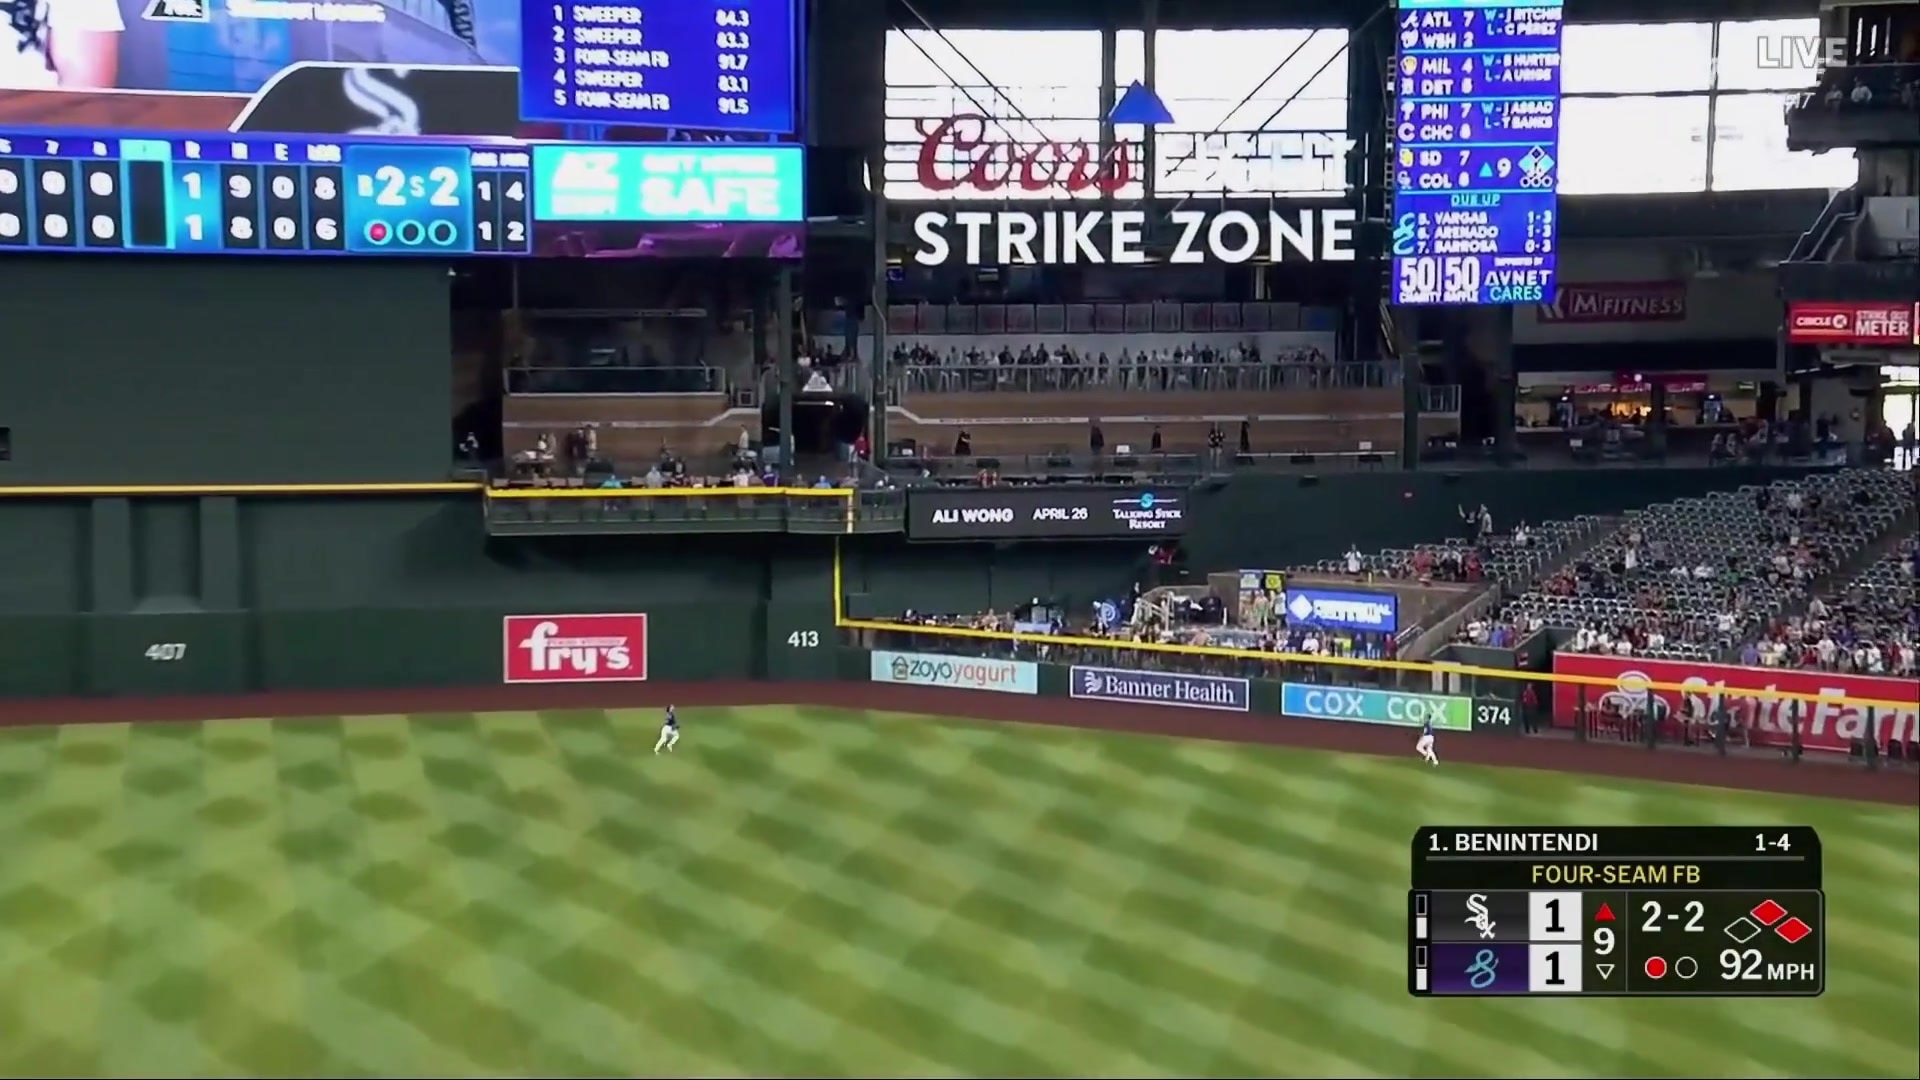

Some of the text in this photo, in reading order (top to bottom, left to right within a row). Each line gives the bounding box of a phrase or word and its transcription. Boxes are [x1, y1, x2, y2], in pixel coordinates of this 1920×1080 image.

[553, 4, 563, 22] 1
[572, 5, 642, 24] SWEEPER
[1421, 11, 1452, 28] ATL
[1463, 11, 1475, 28] 7
[552, 25, 750, 49] 2 SWEEPER 83.3
[1504, 22, 1515, 36] C
[1463, 31, 1474, 48] 2
[553, 46, 748, 71] 3 FOUR-SEAM FB 91.7
[1421, 57, 1451, 75] MIL
[1461, 57, 1473, 74] 4
[553, 68, 566, 85] 4
[574, 69, 644, 88] SWEEPER
[1502, 69, 1513, 82] A
[1420, 79, 1454, 96] DET
[553, 88, 750, 115] 5 FOUR-SEAM FB 91.5
[1420, 103, 1449, 120] PHI
[1461, 102, 1472, 119] 7
[1420, 124, 1454, 141] CHC
[273, 143, 289, 161] E
[915, 113, 1131, 192] Coors
[1459, 150, 1471, 166] 7
[1497, 158, 1511, 178] 9
[41, 170, 66, 195] 0
[182, 171, 201, 199] 1
[228, 174, 252, 199] 9
[271, 175, 294, 200] 0
[314, 176, 337, 201] 8
[375, 165, 407, 206] 2
[409, 175, 426, 198] S
[429, 166, 460, 206] 2
[476, 180, 525, 202] 1 4
[1419, 173, 1453, 189] COL
[640, 177, 780, 216] SAFE
[1481, 194, 1501, 206] UP
[43, 213, 69, 239] 0
[184, 214, 203, 241] 1
[229, 215, 253, 240] 8
[273, 216, 296, 241] 0
[315, 217, 338, 241] 6
[477, 220, 525, 242] 1 2
[913, 208, 1357, 266] STRIKE ZONE
[1490, 286, 1542, 301] CARES
[1855, 320, 1909, 336] METER
[932, 508, 1088, 523] ALI WONG APRIL 26
[518, 621, 630, 675] fry's
[787, 630, 819, 648] 413
[144, 642, 187, 661] 407
[1105, 675, 1235, 704] Banner Health
[1305, 689, 1448, 724] COX COX
[1476, 704, 1512, 726] 374
